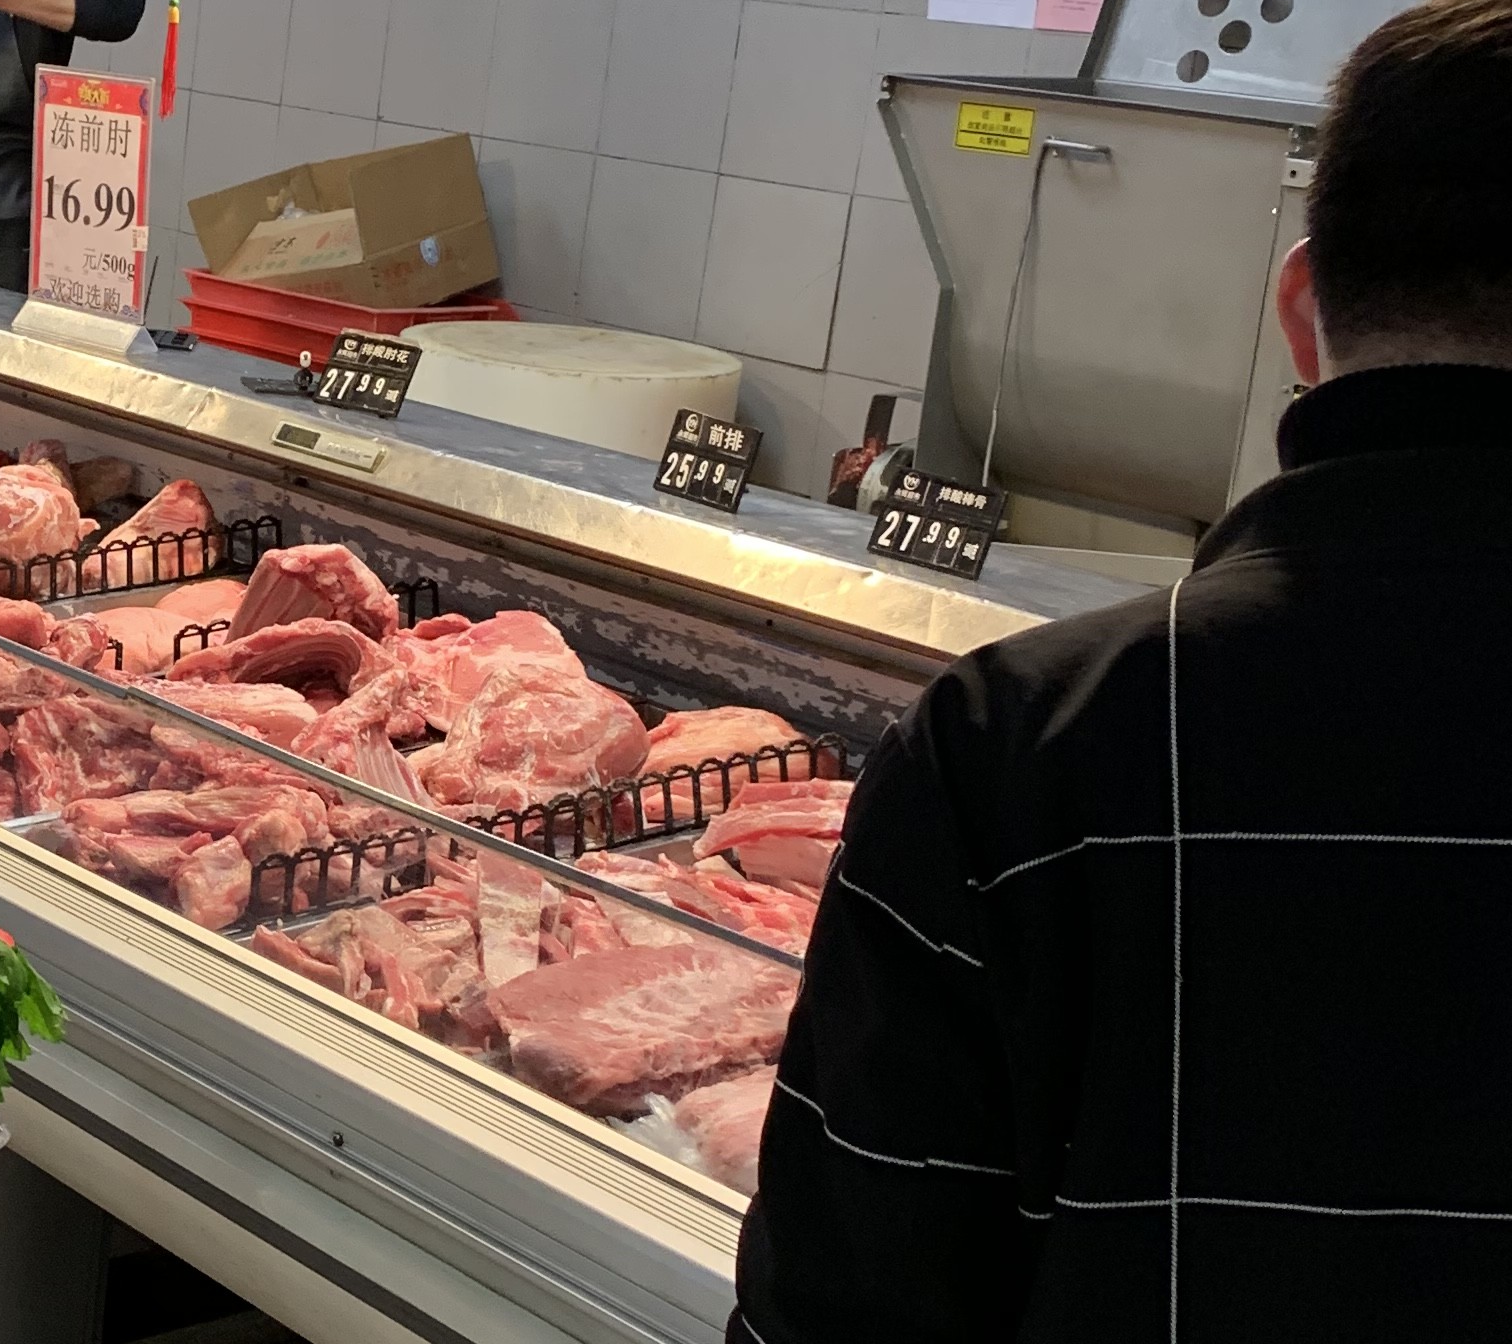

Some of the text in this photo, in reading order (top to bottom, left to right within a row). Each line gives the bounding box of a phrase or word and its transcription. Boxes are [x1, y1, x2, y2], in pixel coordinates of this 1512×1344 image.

[51, 111, 132, 158] 冻前肘
[43, 175, 135, 231] 16.99
[82, 247, 135, 281] 元/500g
[50, 278, 121, 314] 欢迎选购
[708, 423, 745, 452] 前排
[660, 452, 725, 489] 25.99
[877, 510, 961, 552] 27.99
